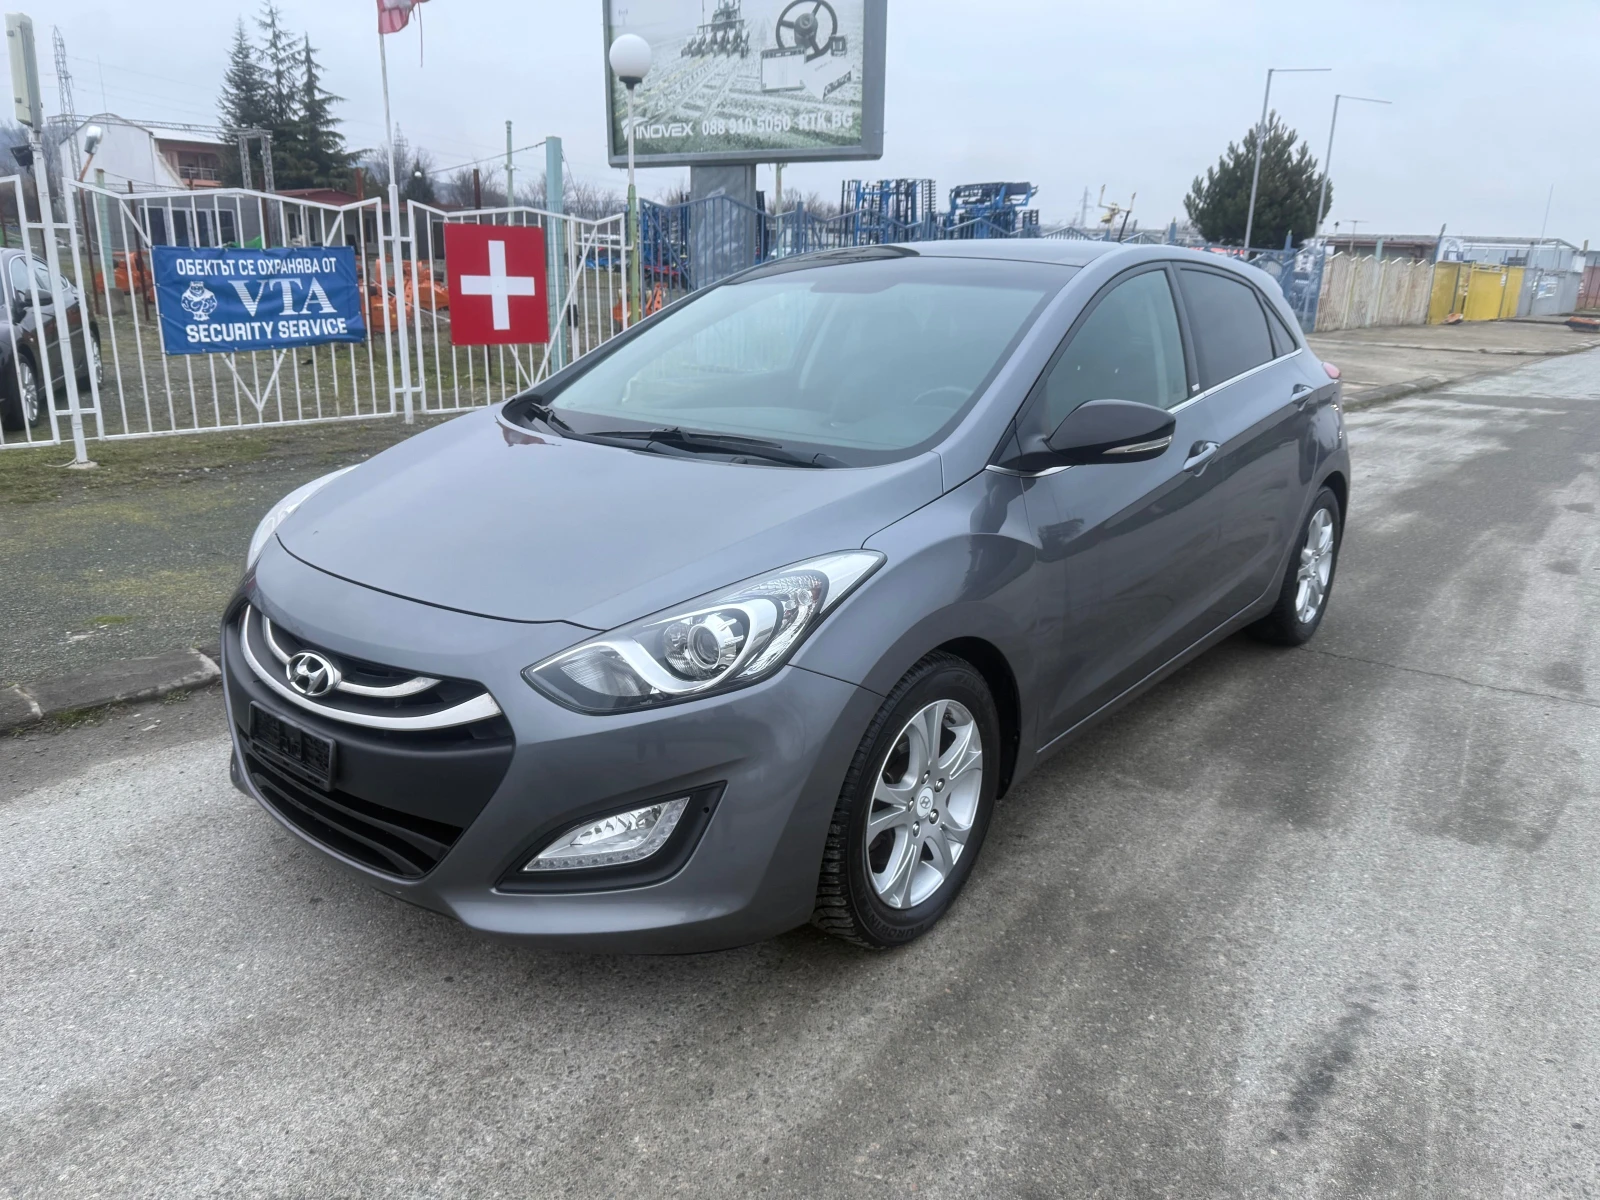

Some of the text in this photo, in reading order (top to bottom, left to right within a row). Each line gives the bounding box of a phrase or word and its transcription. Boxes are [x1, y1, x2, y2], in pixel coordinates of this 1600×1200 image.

[701, 115, 791, 136] 088 910 5050
[799, 110, 853, 130] RTK.BG
[176, 257, 337, 276] ОБЕКТЪТ СЕ ОХРАНЯВА ОТ
[227, 276, 338, 317] VTA
[185, 318, 348, 343] SECURITY SERVICE
